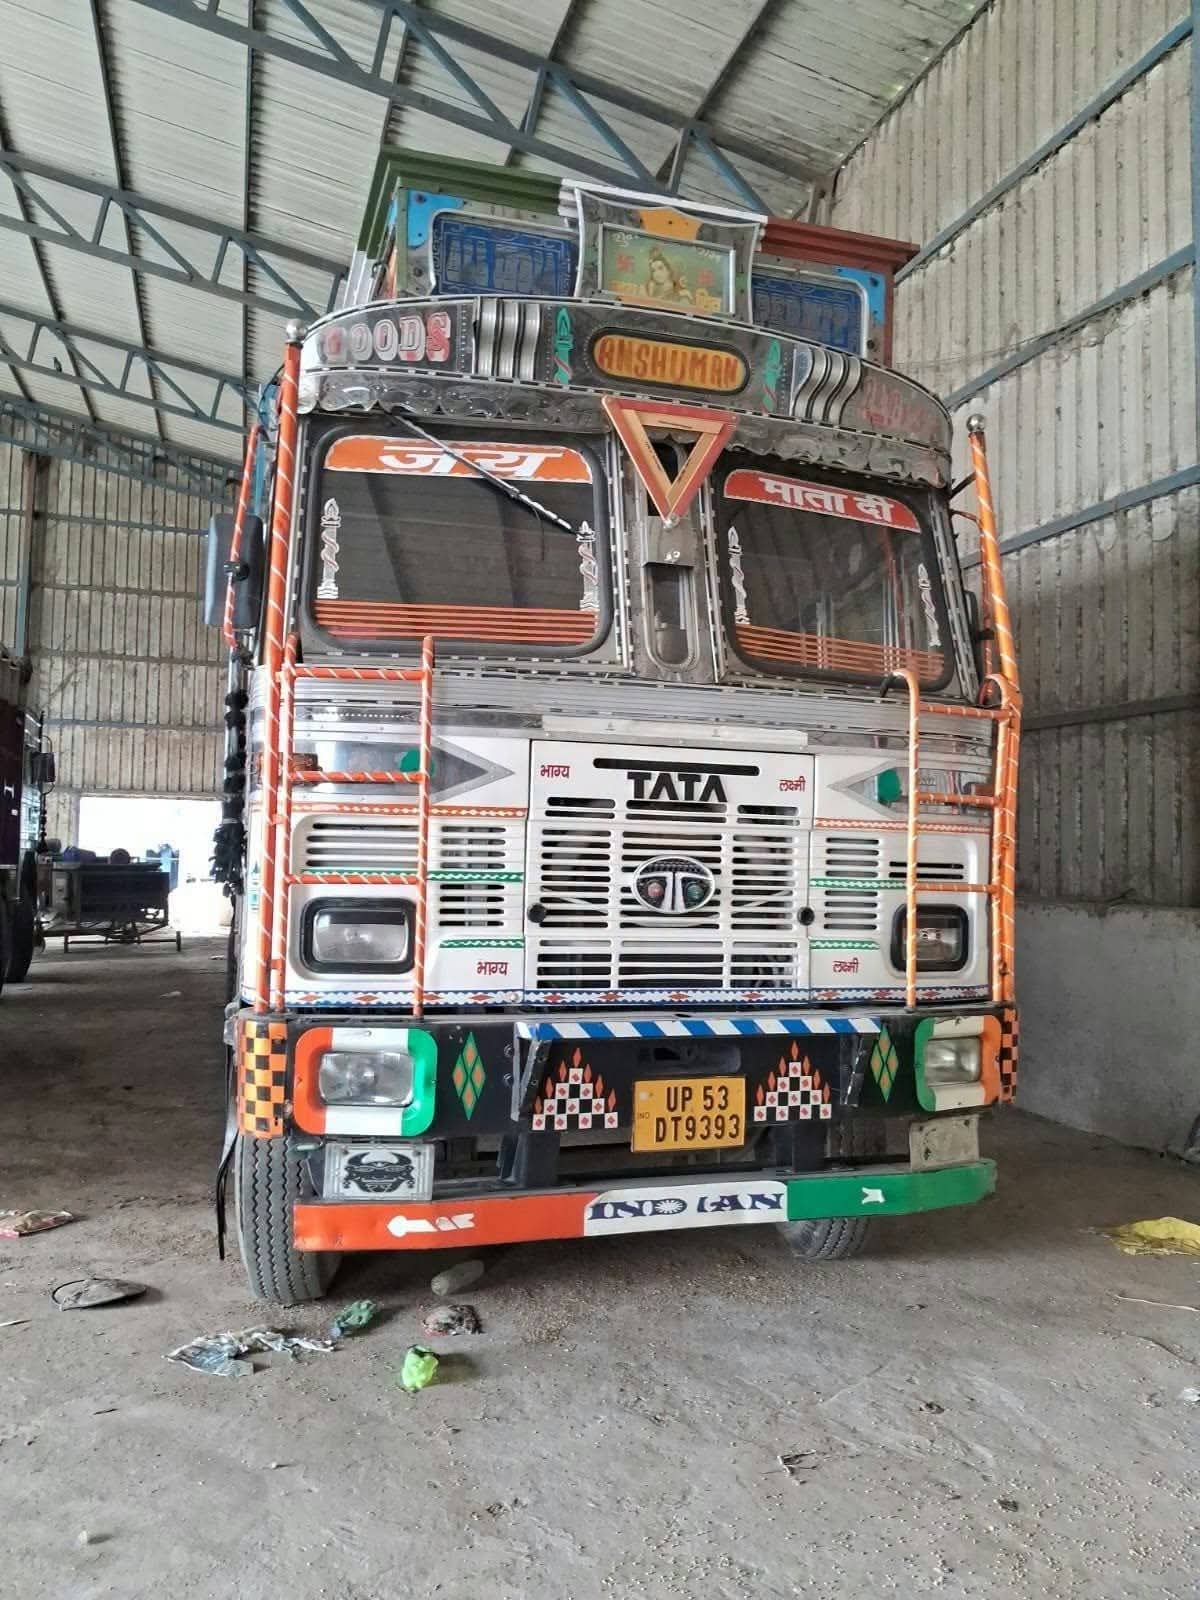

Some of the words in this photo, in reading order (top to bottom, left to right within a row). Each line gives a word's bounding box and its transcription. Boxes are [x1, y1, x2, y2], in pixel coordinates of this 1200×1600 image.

[599, 337, 740, 390] ANSHUMAN
[759, 477, 849, 514] माता
[856, 496, 896, 523] दी
[540, 764, 571, 780] भाग्य
[627, 771, 728, 802] TATA
[476, 961, 510, 976] भाग्य
[666, 1086, 693, 1113] UP
[703, 1085, 730, 1111] 53
[655, 1113, 741, 1143] DT9393
